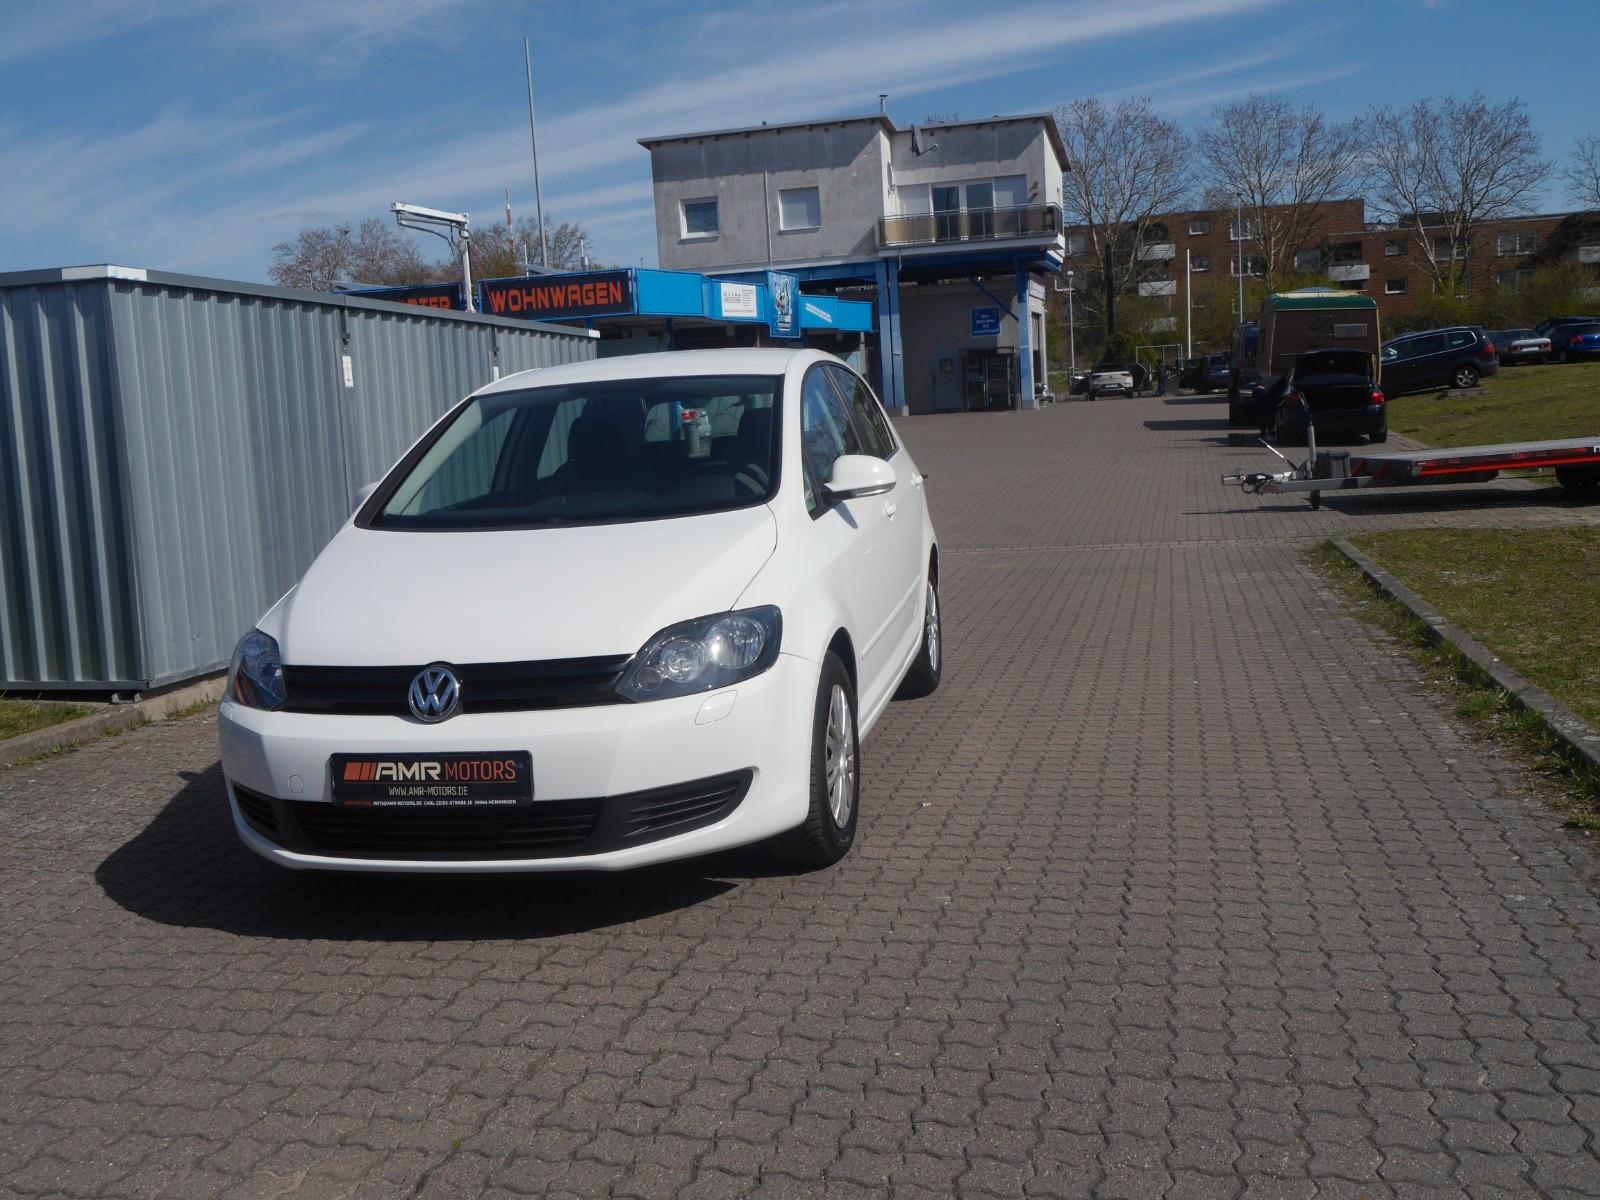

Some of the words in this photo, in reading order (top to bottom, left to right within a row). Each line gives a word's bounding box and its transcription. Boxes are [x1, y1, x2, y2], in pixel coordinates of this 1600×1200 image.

[490, 281, 623, 313] WOHNWAGEN
[375, 761, 442, 781] AMR
[445, 760, 517, 781] MOTORS
[388, 786, 469, 797] WWW.AMR-MOTORS.DE
